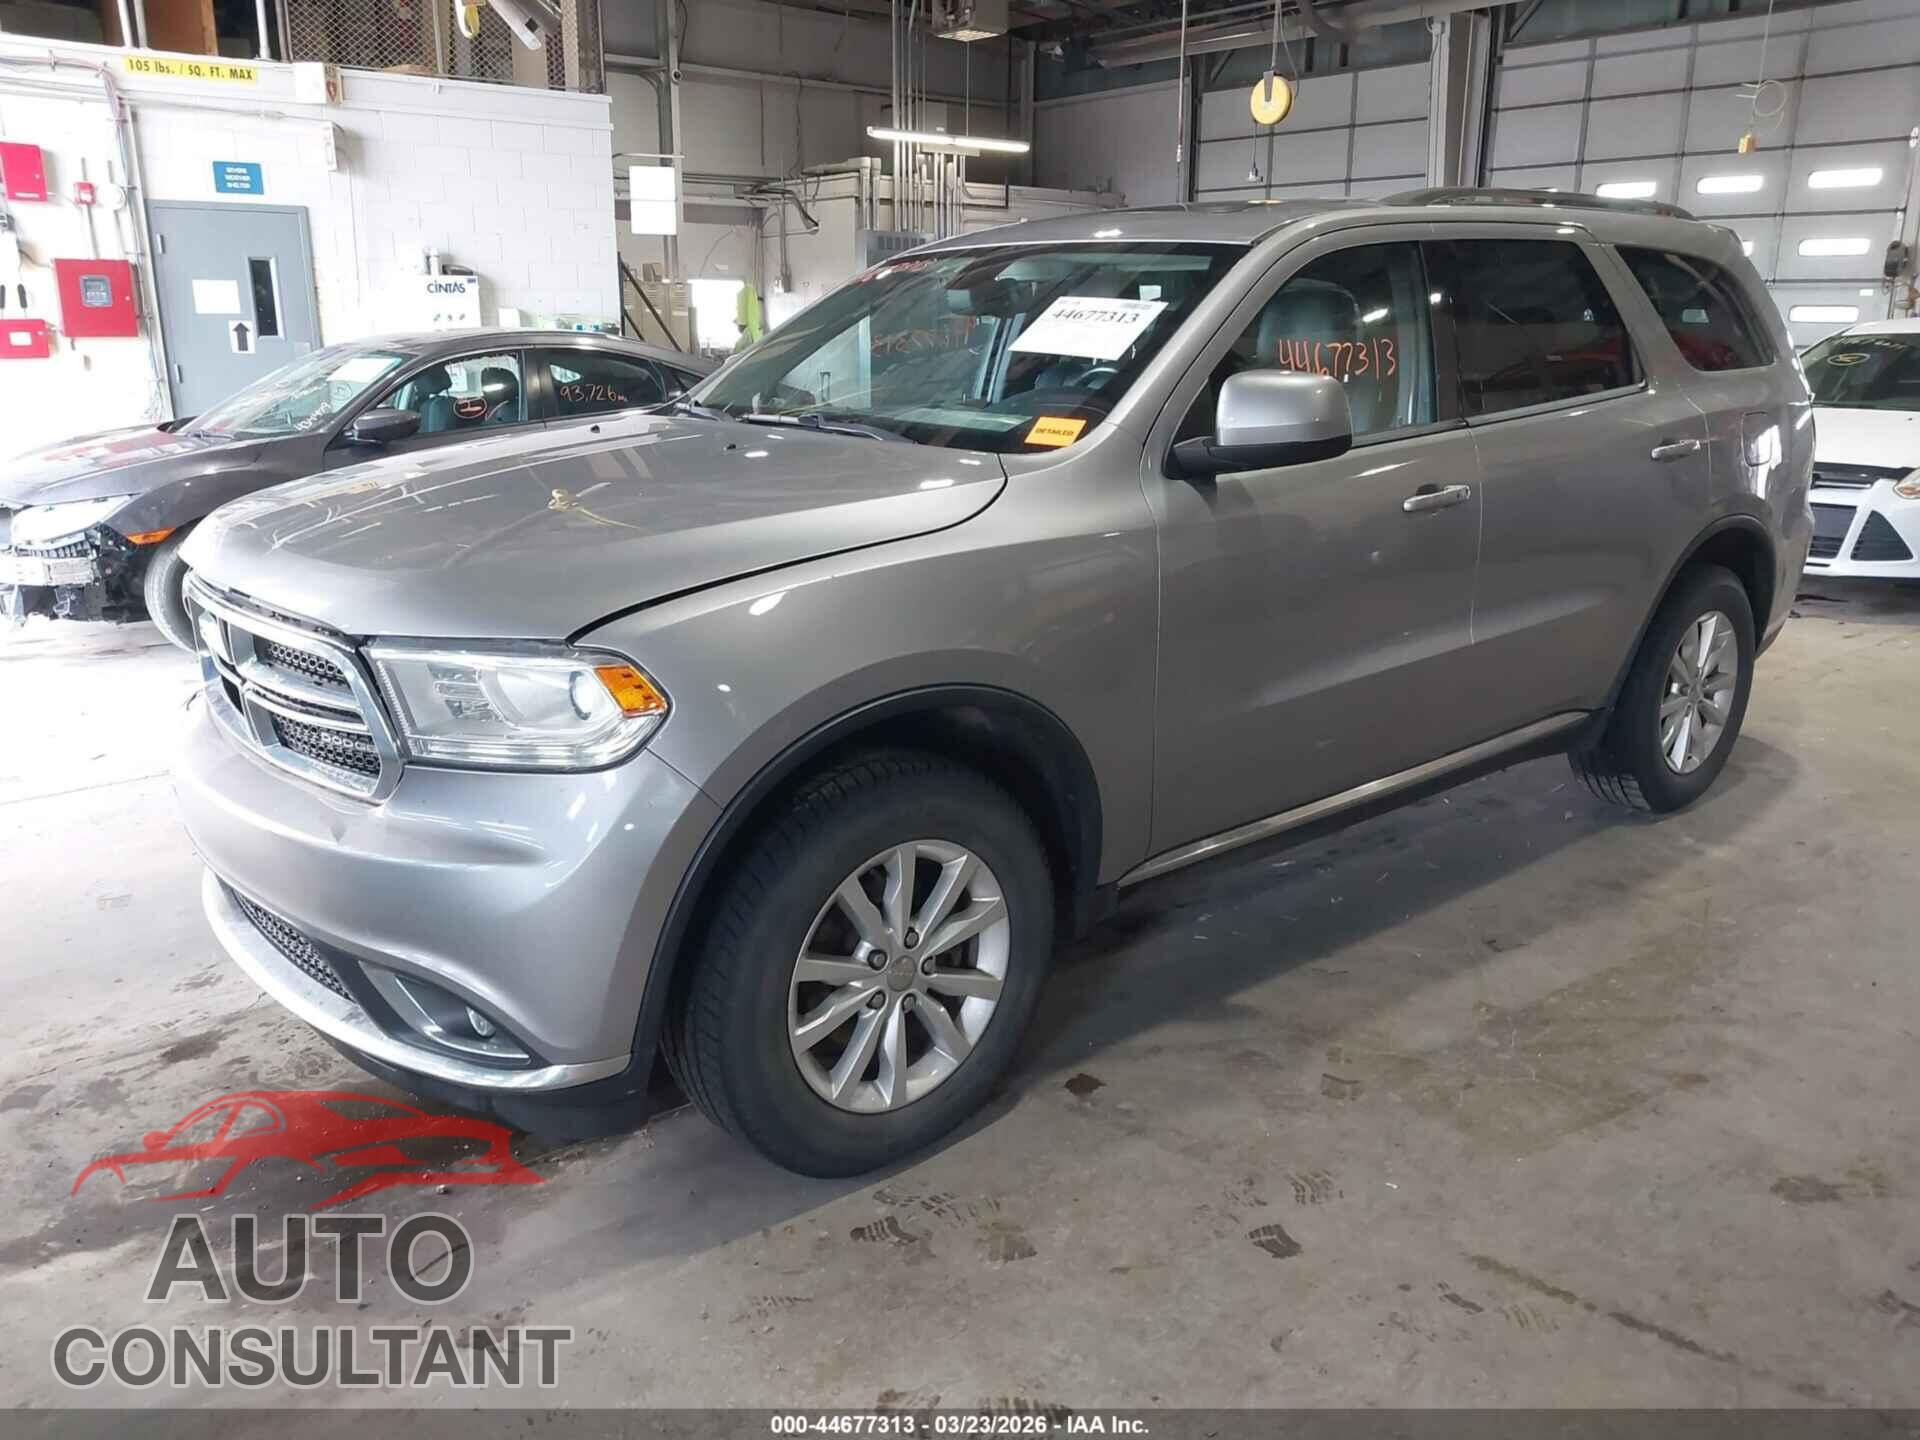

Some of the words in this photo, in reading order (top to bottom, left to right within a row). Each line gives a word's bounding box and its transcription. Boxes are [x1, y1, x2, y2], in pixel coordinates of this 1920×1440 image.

[128, 58, 151, 72] 105
[154, 61, 176, 75] lbs.
[187, 65, 206, 77] SQ.
[209, 66, 226, 78] FT.
[229, 68, 253, 80] MAX
[426, 280, 466, 294] CINTAS
[1052, 308, 1142, 324] 44677313
[1278, 337, 1396, 379] 44677313
